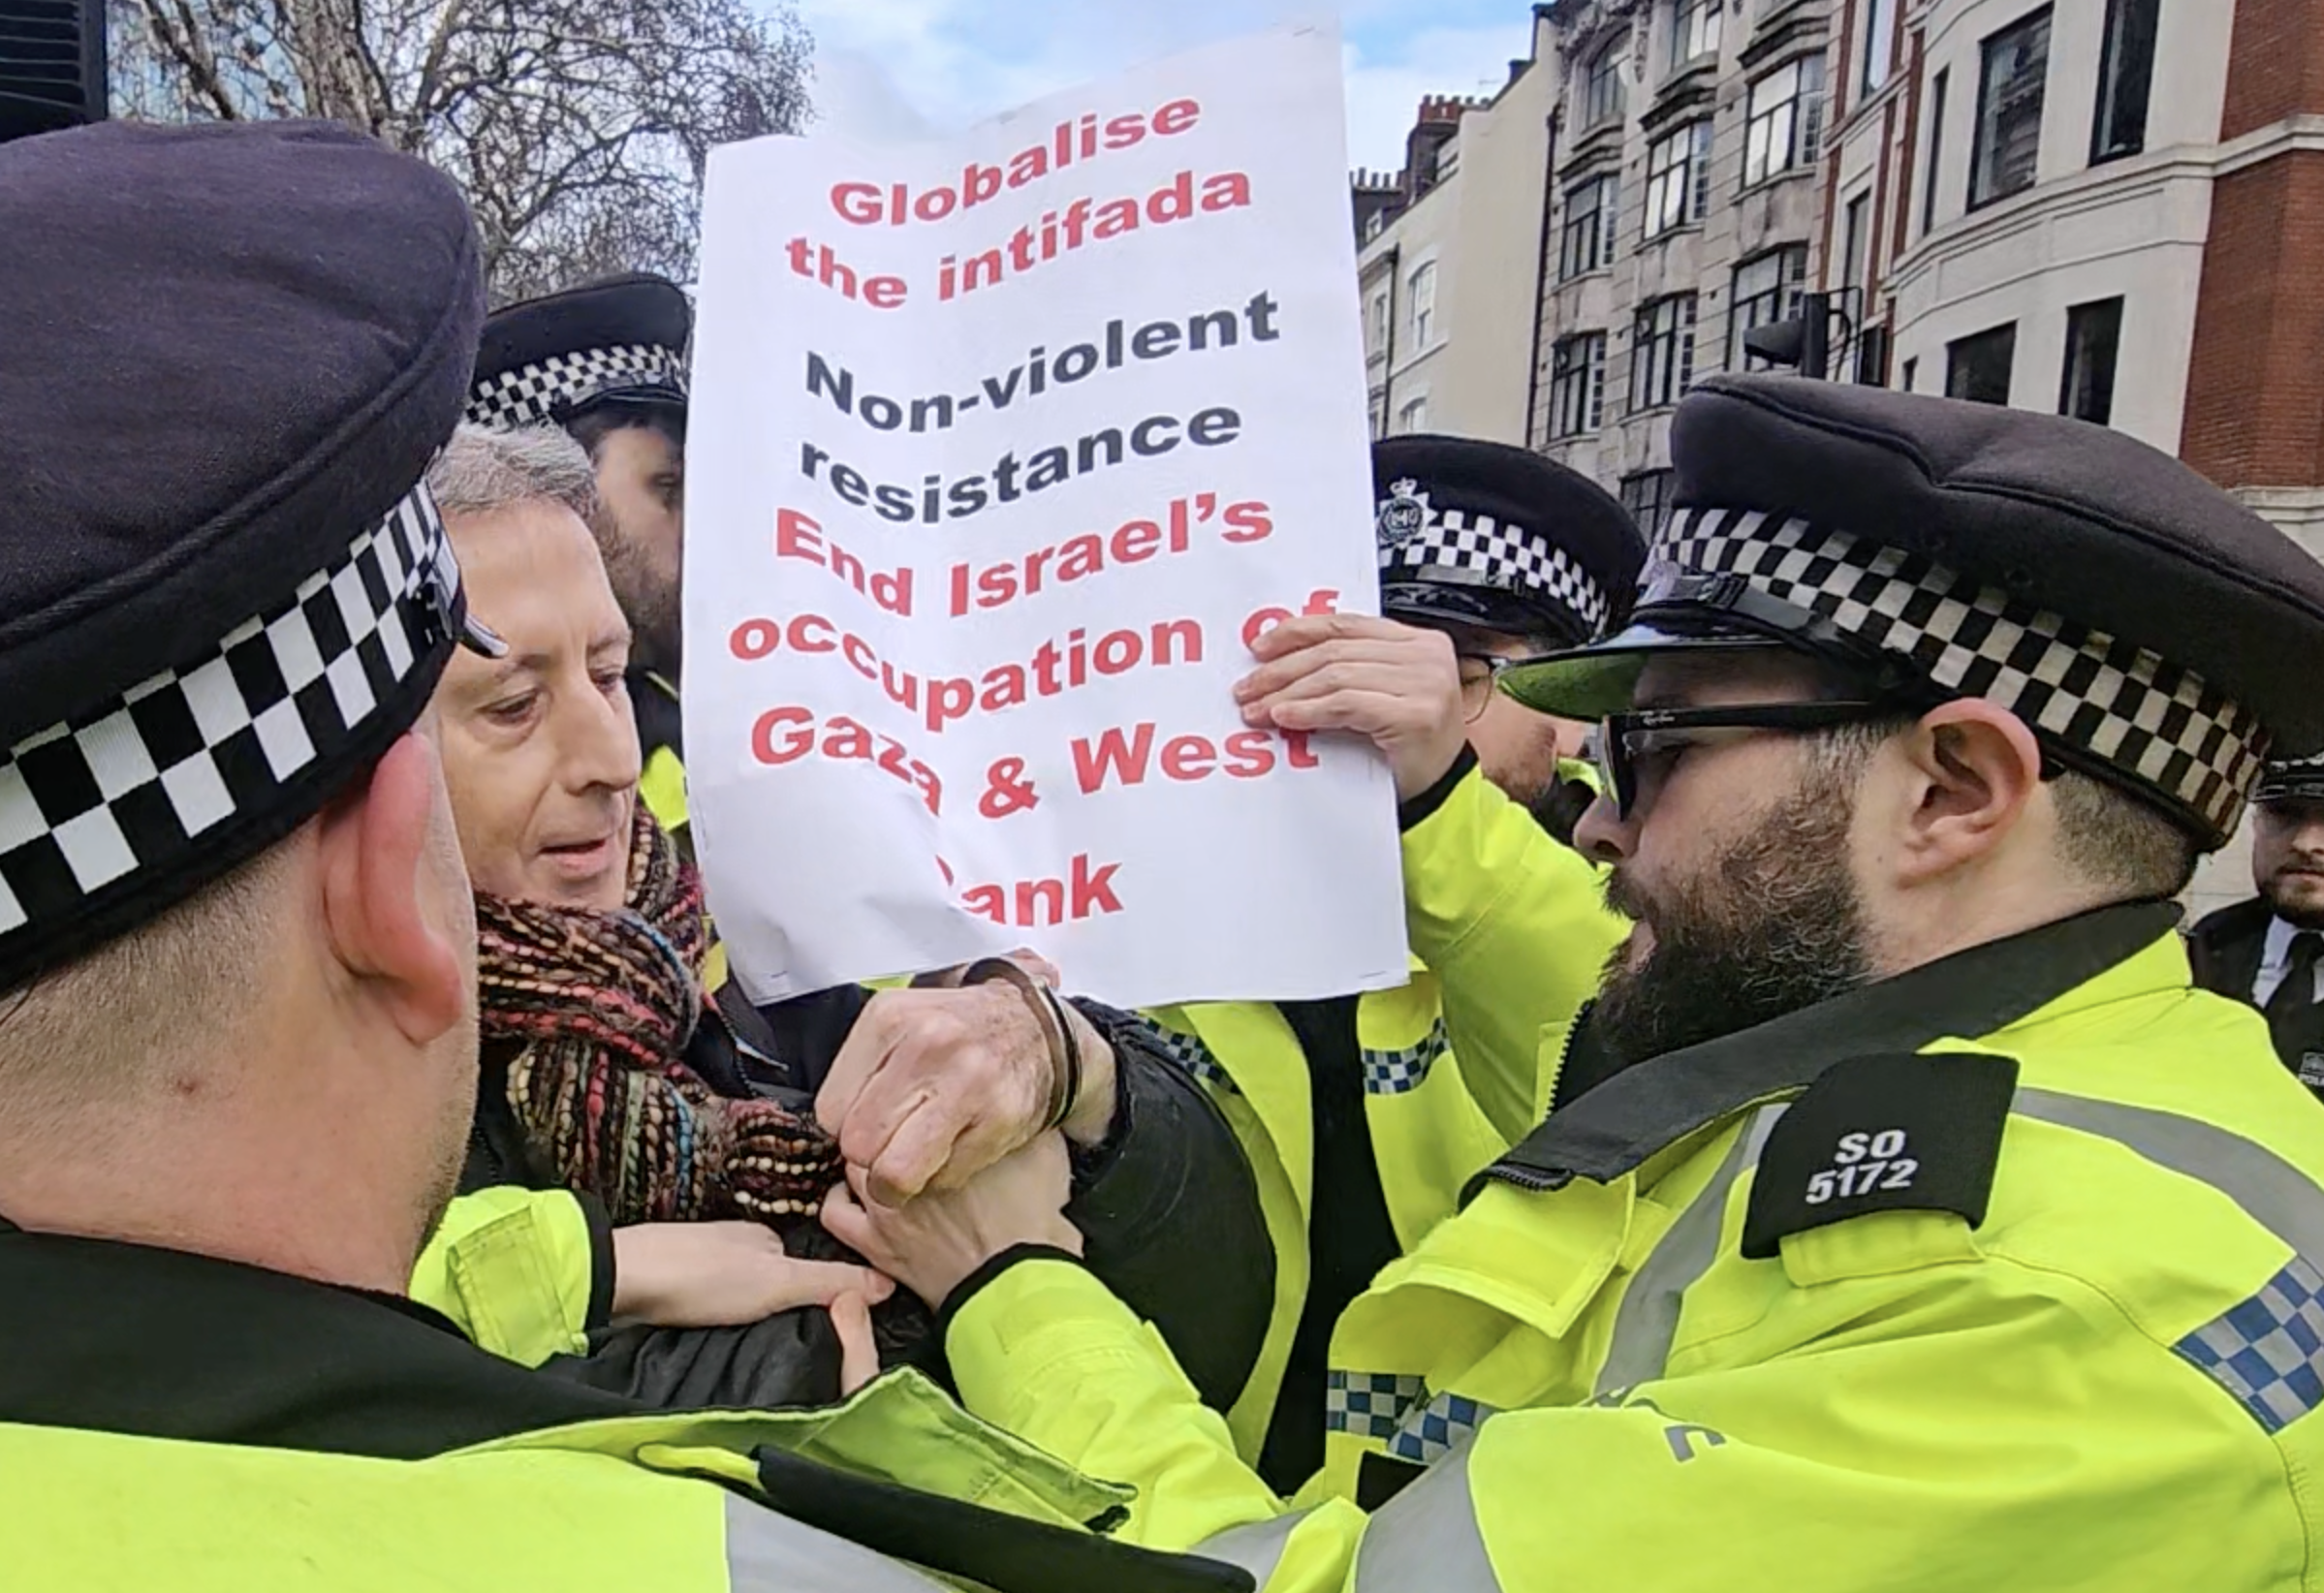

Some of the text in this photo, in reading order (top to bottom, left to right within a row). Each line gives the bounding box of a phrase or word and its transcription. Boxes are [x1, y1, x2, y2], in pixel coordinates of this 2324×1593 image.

[831, 98, 1201, 225] Globalise
[786, 171, 1252, 308] the intifada
[805, 290, 1280, 432] Non-violent
[801, 407, 1241, 523] resistance
[777, 508, 913, 614] End
[729, 614, 1202, 733] occupation
[751, 706, 1321, 820] Gaza & West
[934, 853, 1124, 927] ank
[1805, 1157, 1919, 1204] 5172
[1834, 1128, 1906, 1164] SO
